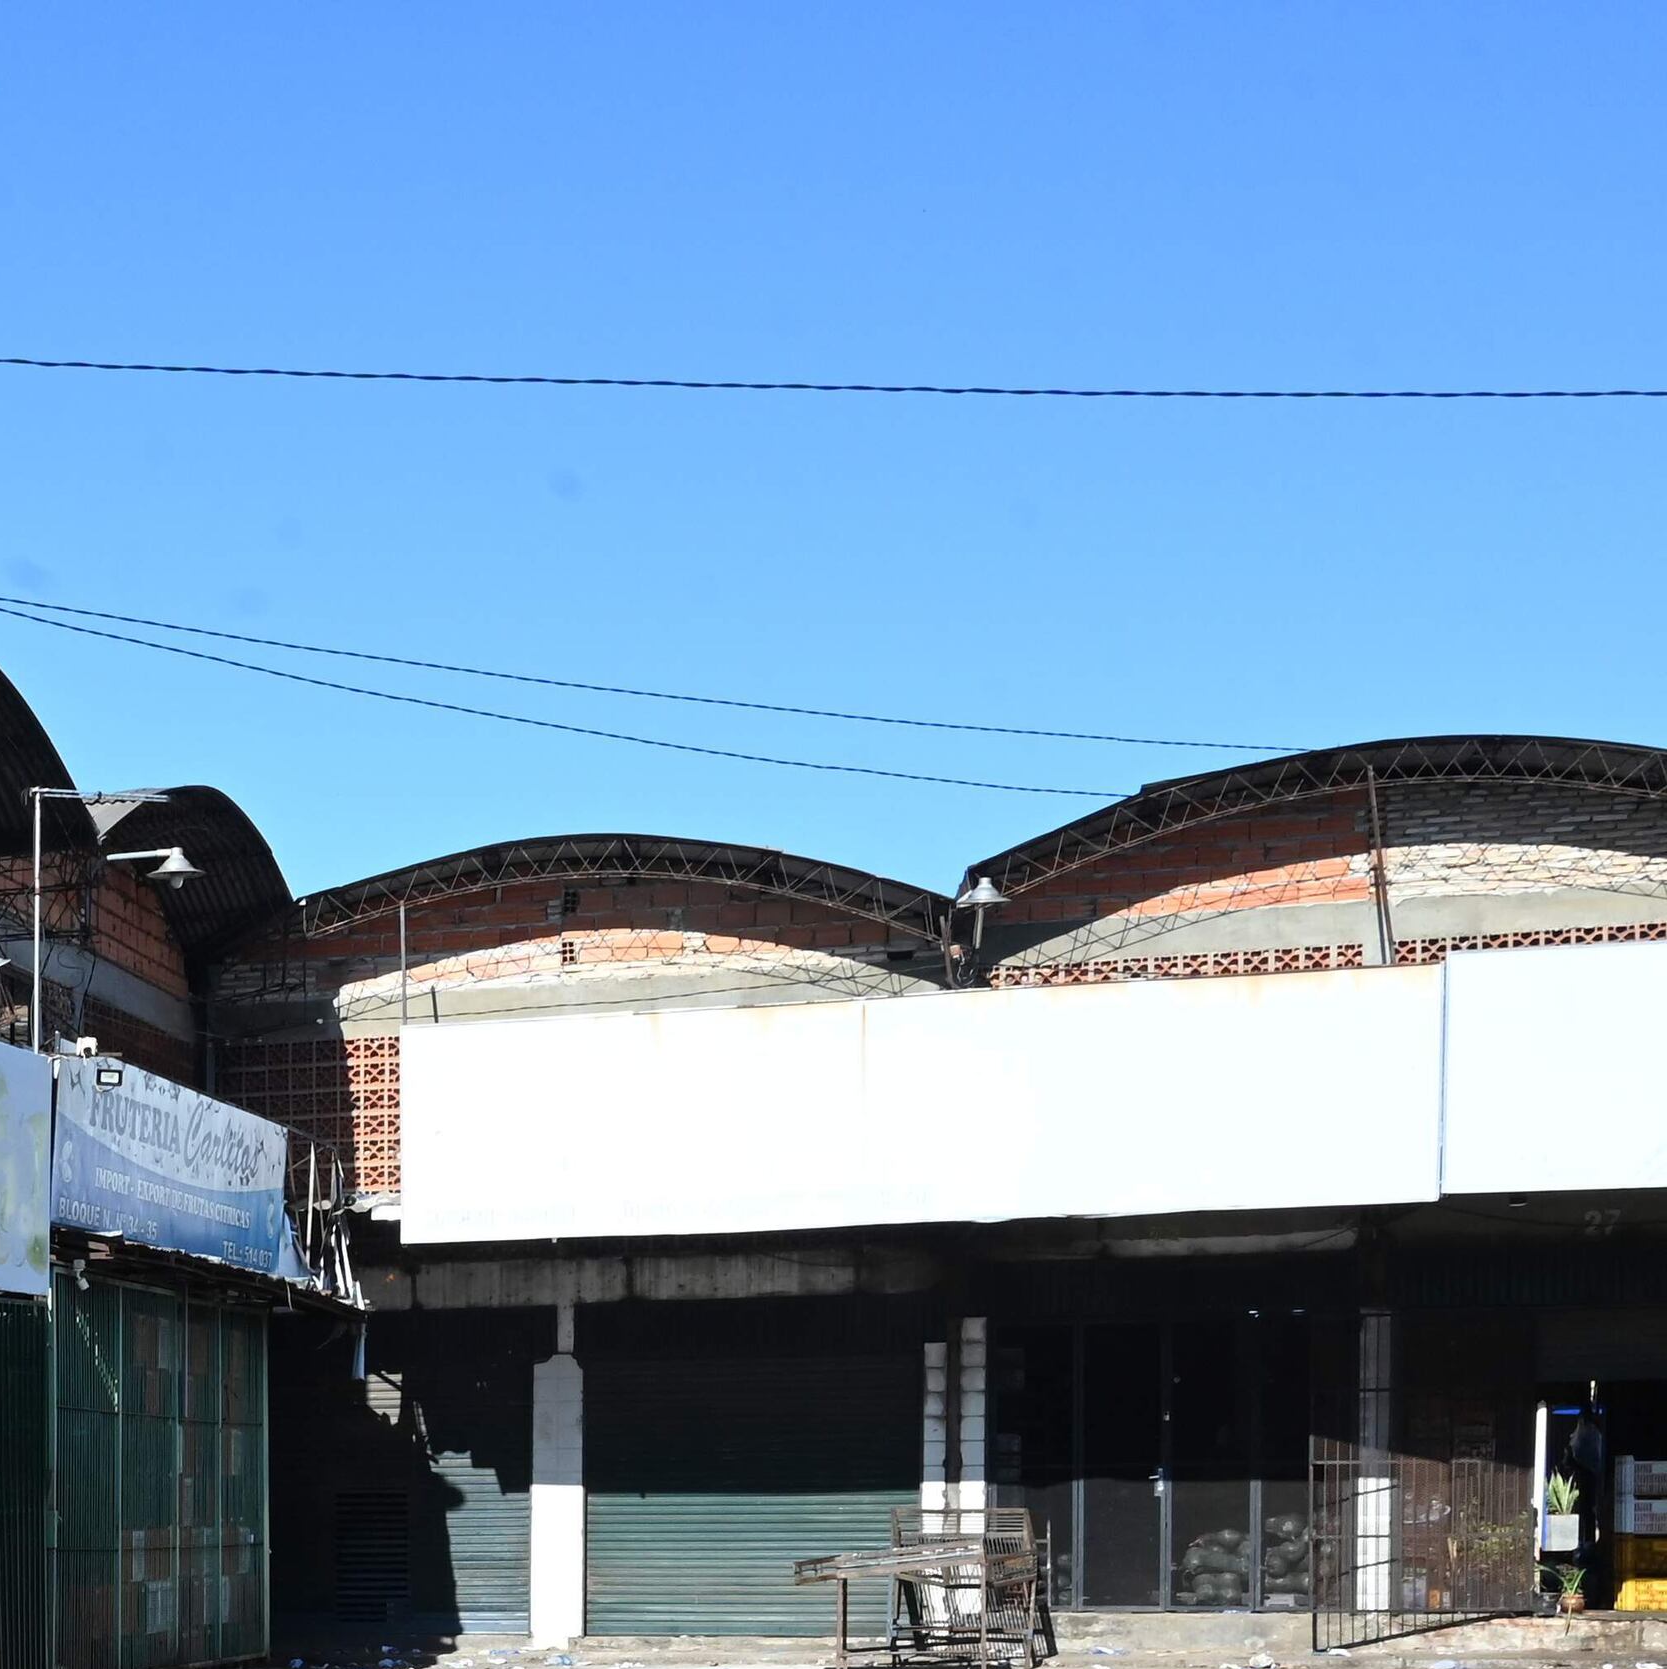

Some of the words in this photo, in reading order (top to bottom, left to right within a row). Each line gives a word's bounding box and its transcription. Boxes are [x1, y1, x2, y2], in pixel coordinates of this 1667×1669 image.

[89, 1085, 181, 1154] FRUTERIA
[95, 1167, 131, 1196] IMPORT
[137, 1180, 170, 1206] EXPORT
[171, 1189, 183, 1210] DE
[183, 1192, 215, 1219] FRUTAS
[58, 1198, 100, 1225] BLOQUE
[128, 1214, 139, 1234] 34
[146, 1220, 158, 1240] 35
[1584, 1209, 1622, 1236] 27
